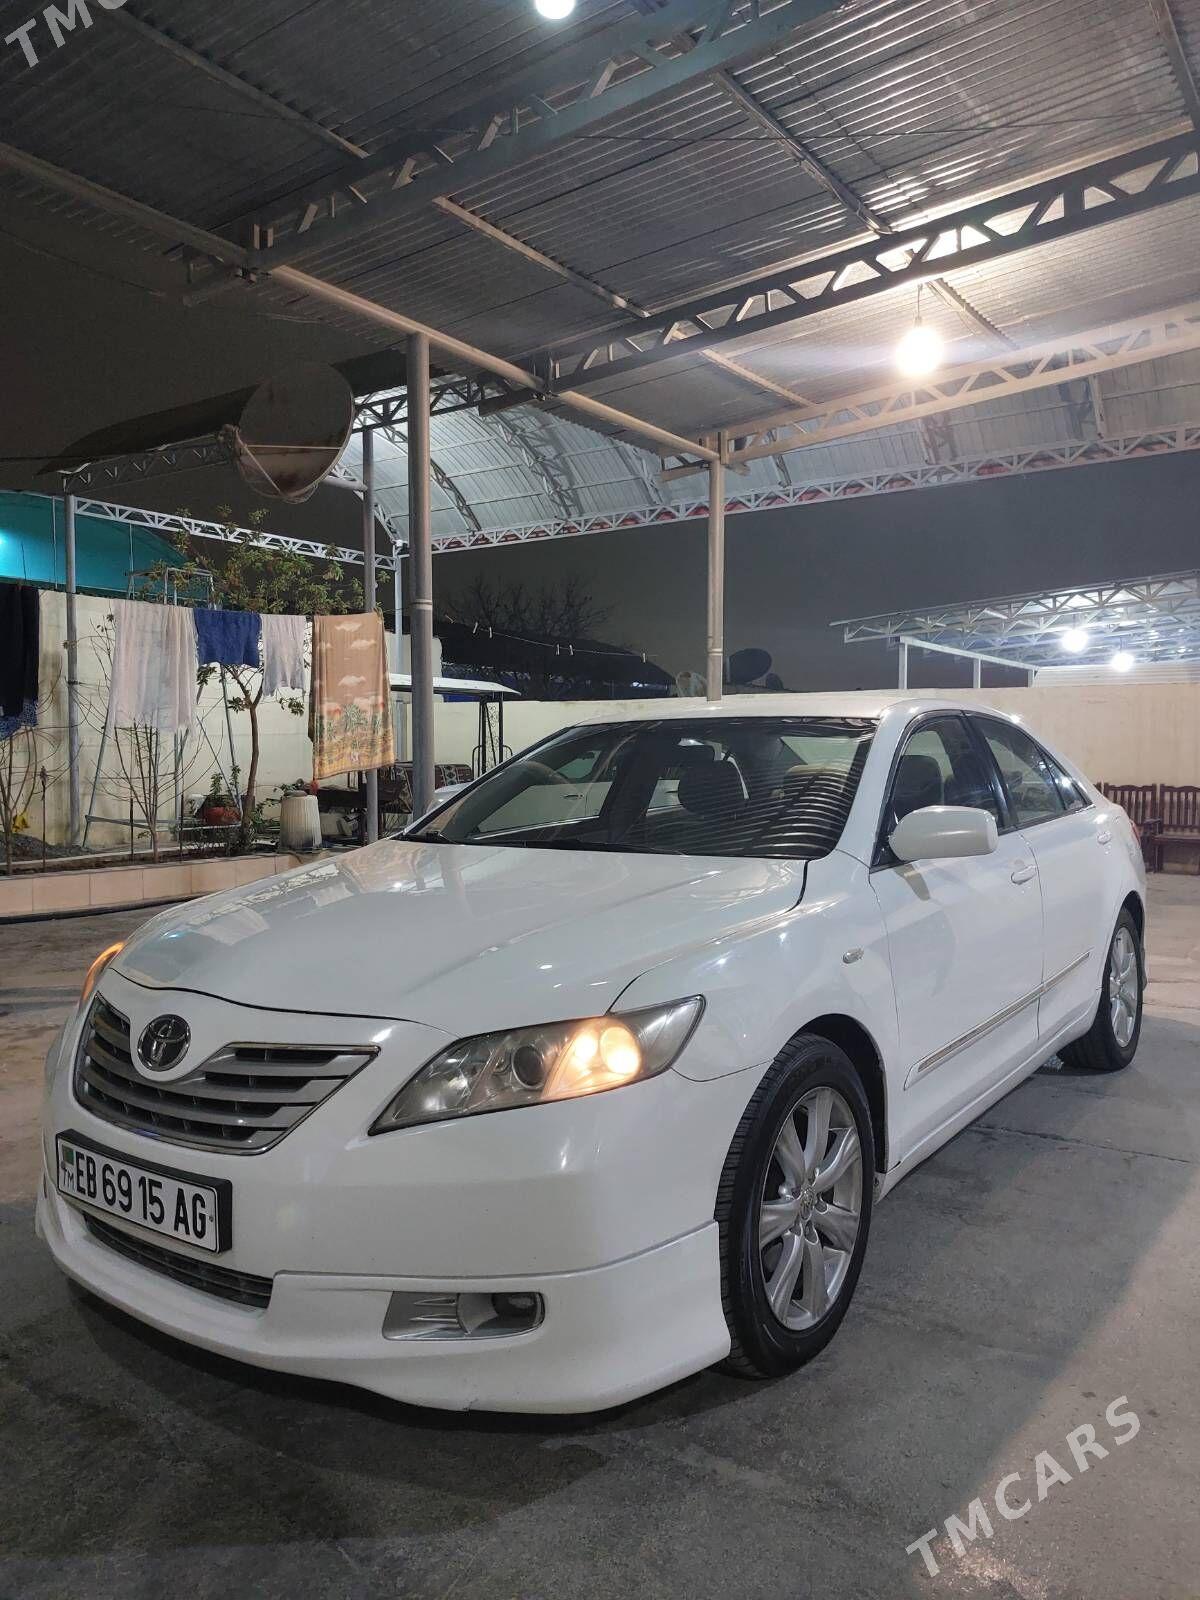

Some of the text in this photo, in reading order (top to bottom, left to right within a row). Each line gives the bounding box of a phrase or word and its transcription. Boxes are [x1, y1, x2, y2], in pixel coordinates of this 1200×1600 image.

[75, 1151, 206, 1239] EB 69 15 AG
